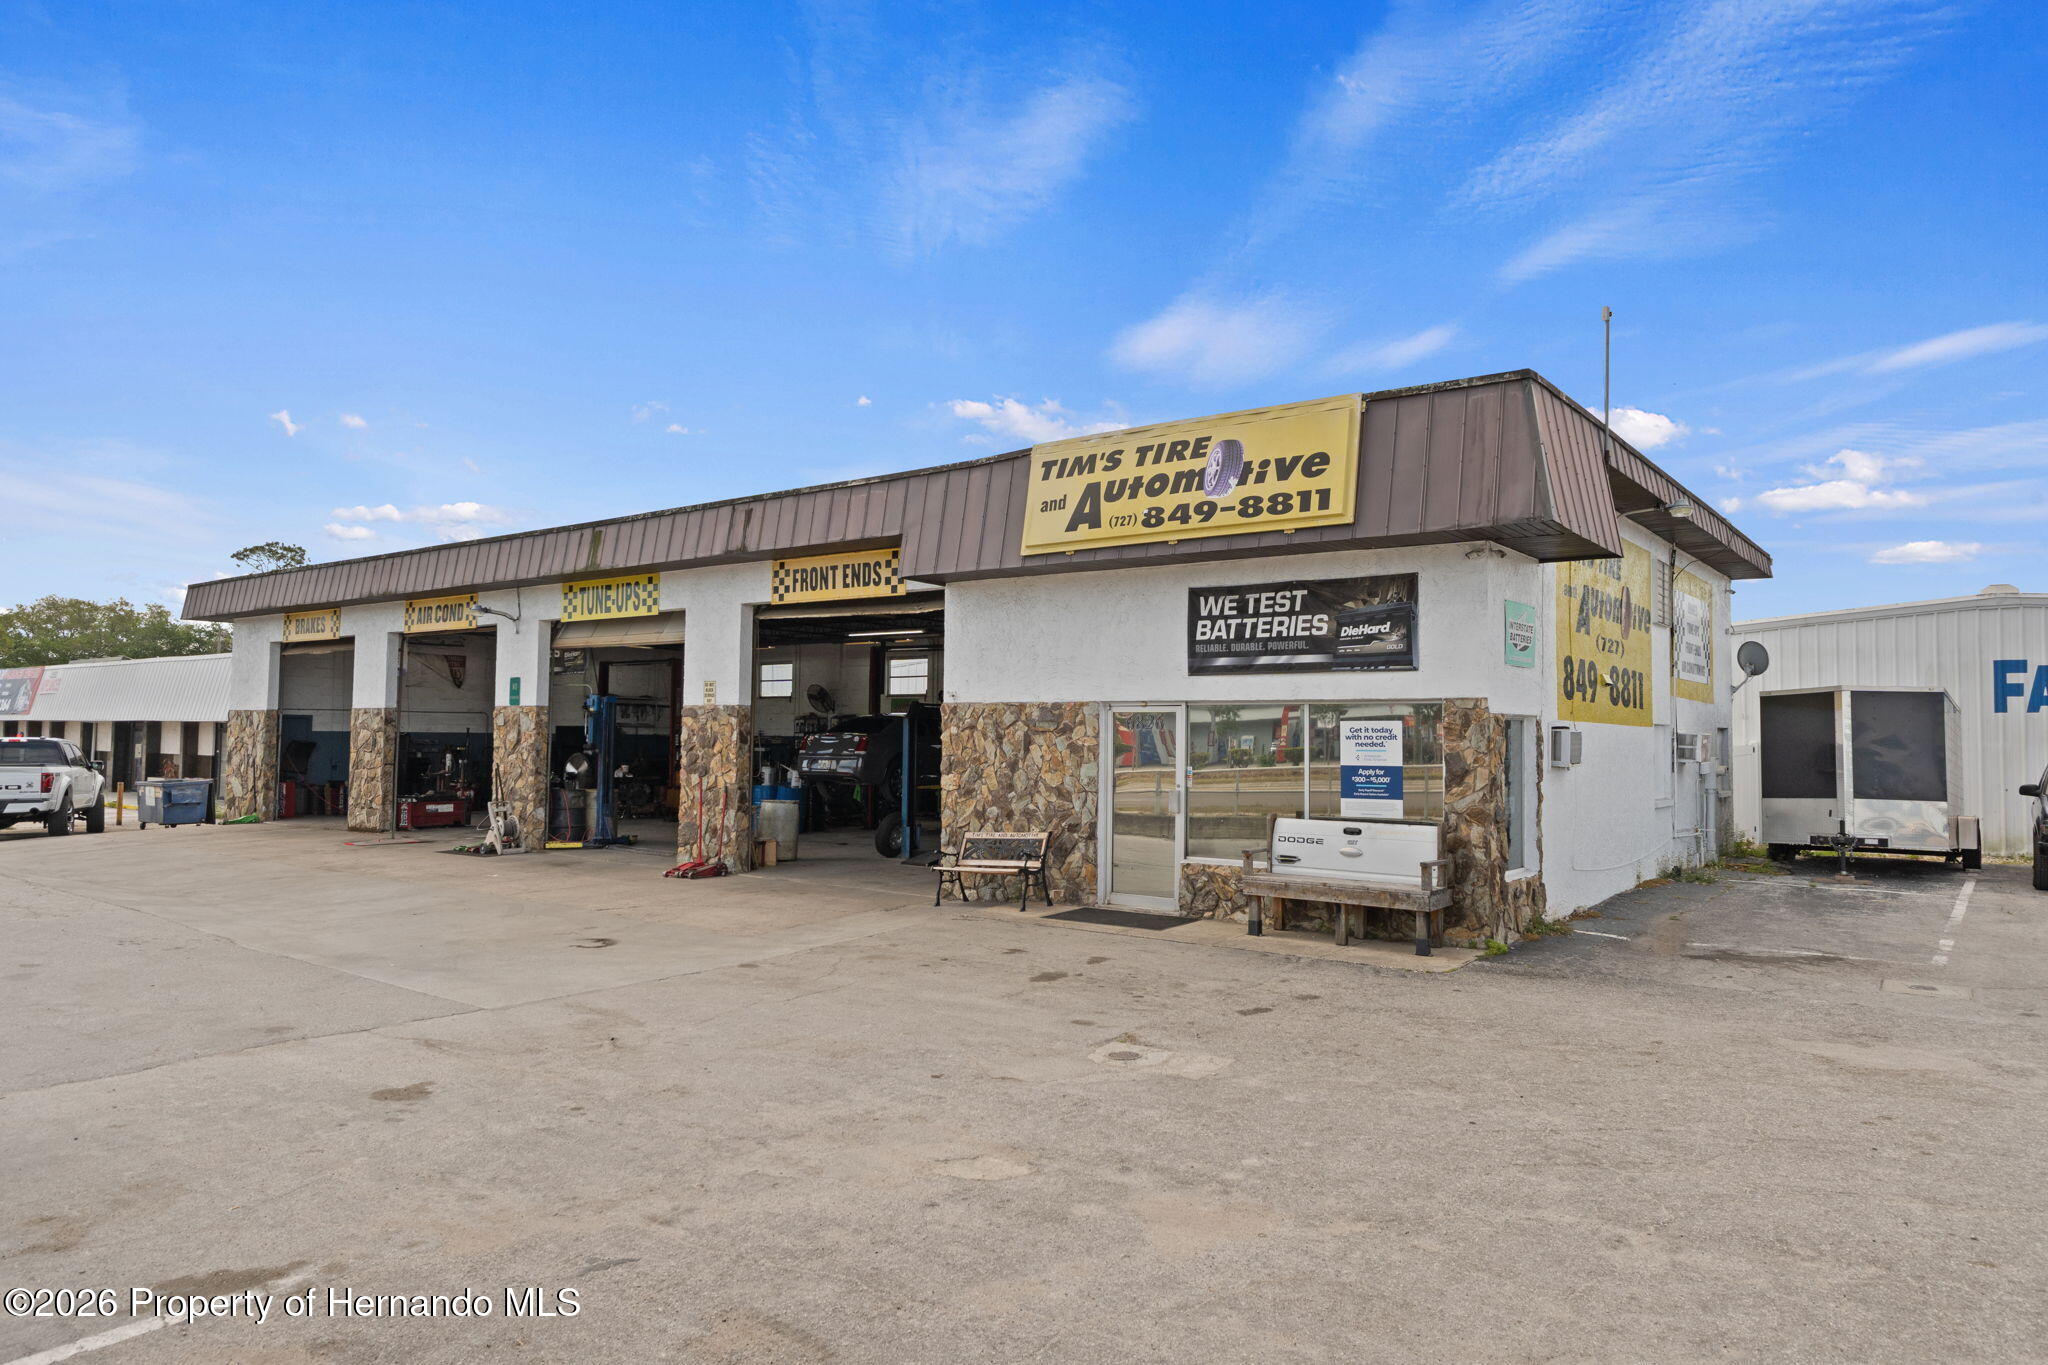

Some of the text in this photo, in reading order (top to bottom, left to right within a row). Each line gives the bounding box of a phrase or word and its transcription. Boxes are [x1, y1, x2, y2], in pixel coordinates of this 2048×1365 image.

[1041, 436, 1212, 481] TIM'S TIRE
[1041, 451, 1331, 533] and Automtive
[1109, 488, 1331, 529] (727) 849-8811
[792, 561, 882, 593] FRONT ENDS
[579, 580, 641, 616] TUNE-UPS
[1199, 590, 1308, 616] WE TEST
[295, 616, 326, 634] BRAKES
[416, 603, 464, 625] AIR COND
[1195, 614, 1329, 641] BATTERIES
[1341, 621, 1391, 637] DieHard
[1510, 632, 1532, 645] BATTERIES
[1196, 640, 1309, 653] RELIABLE. DURABLE. POWERFUL.
[1596, 633, 1625, 658] (727)
[1372, 727, 1393, 735] today
[1278, 835, 1325, 845] DODGE
